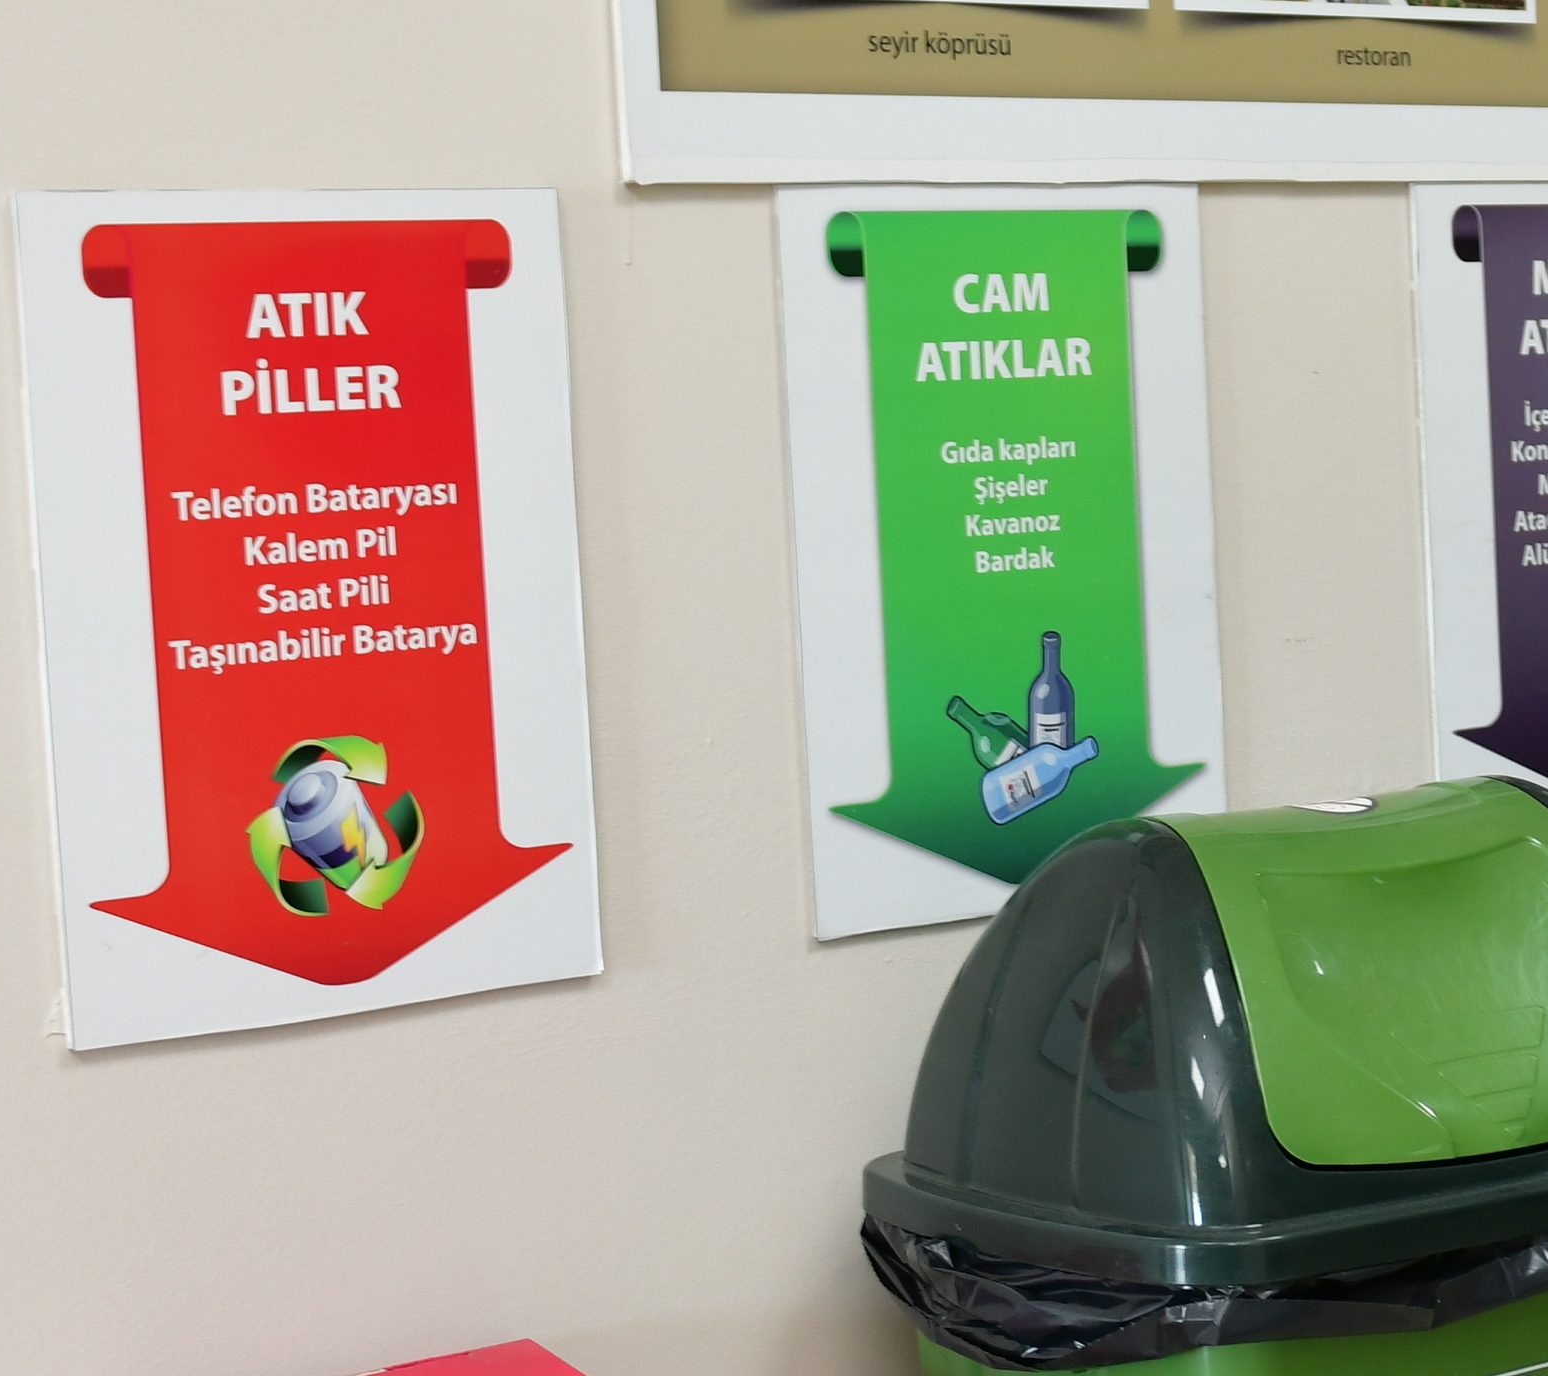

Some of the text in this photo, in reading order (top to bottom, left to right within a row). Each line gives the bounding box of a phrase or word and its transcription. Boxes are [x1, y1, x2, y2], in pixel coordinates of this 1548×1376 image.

[868, 29, 1012, 60] seyir köprüsü
[1337, 46, 1411, 67] restoran
[953, 272, 1050, 314] CAM
[245, 291, 369, 339] ATIK
[916, 337, 1092, 382] ATIKLAR
[220, 358, 401, 416] PİLLER
[940, 435, 1076, 465] Gıda kapları
[171, 482, 458, 522] Telefon Bataryası
[974, 474, 1048, 505] Şişeler
[964, 513, 1061, 537] Kavanoz
[243, 526, 397, 566] Kalem Pil
[975, 545, 1055, 573] Bardak
[258, 574, 390, 614] Saat Pili
[168, 623, 478, 675] Taşınabilir Batarya
